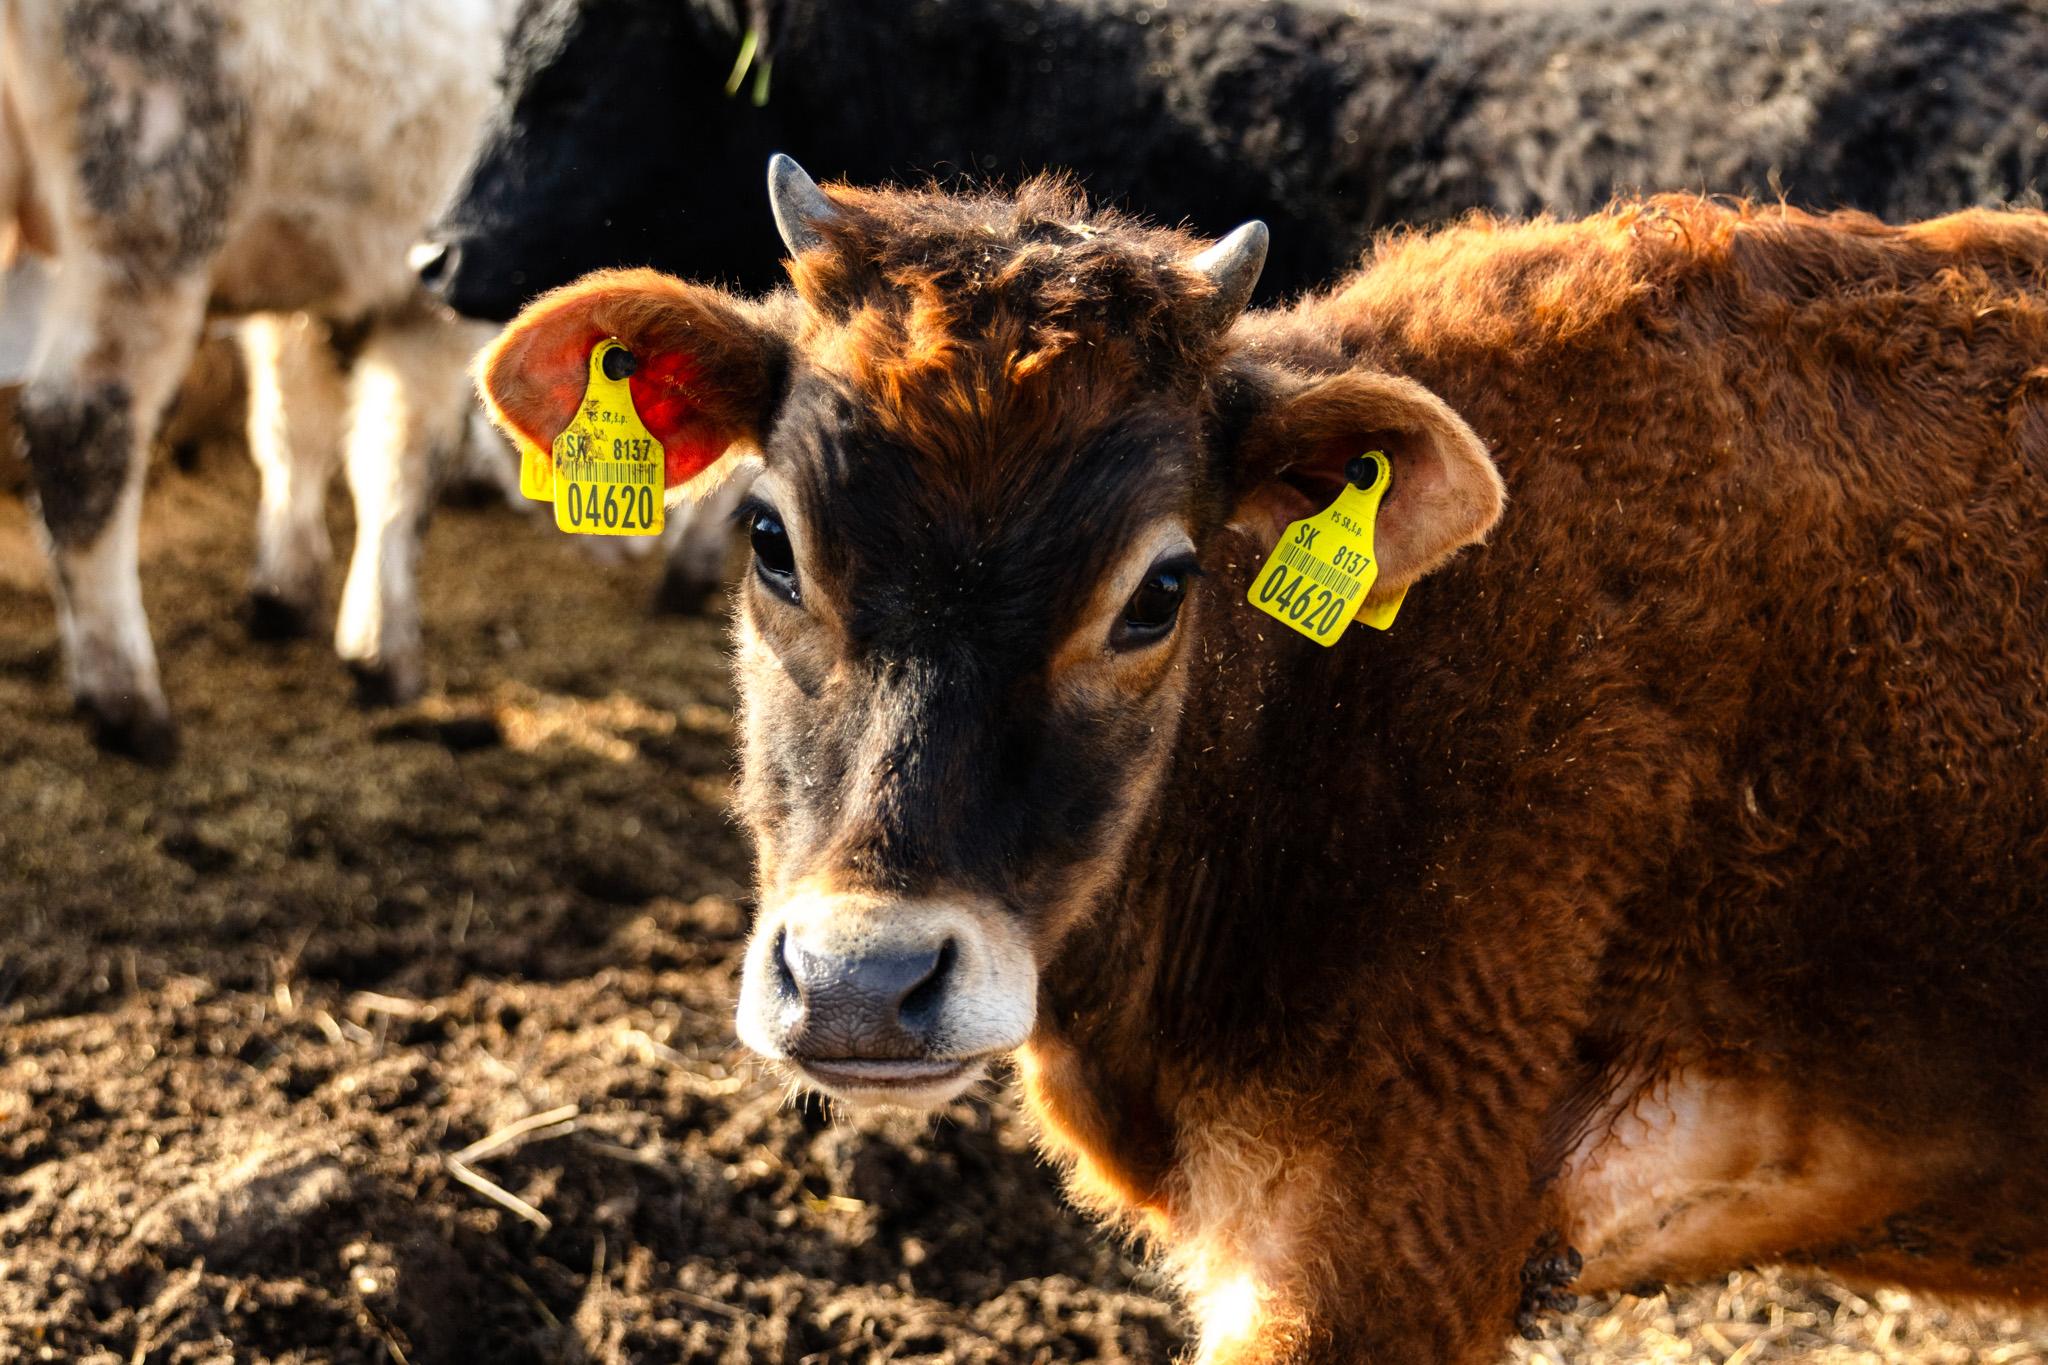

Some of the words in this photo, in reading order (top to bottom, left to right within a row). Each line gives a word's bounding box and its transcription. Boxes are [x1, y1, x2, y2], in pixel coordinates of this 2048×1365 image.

[566, 434, 587, 460] SK
[613, 438, 651, 461] 8137
[568, 483, 653, 530] 04620
[1331, 511, 1341, 523] PS
[1294, 523, 1320, 550] SK
[1333, 546, 1371, 577] 8137
[1259, 565, 1345, 636] 04620
